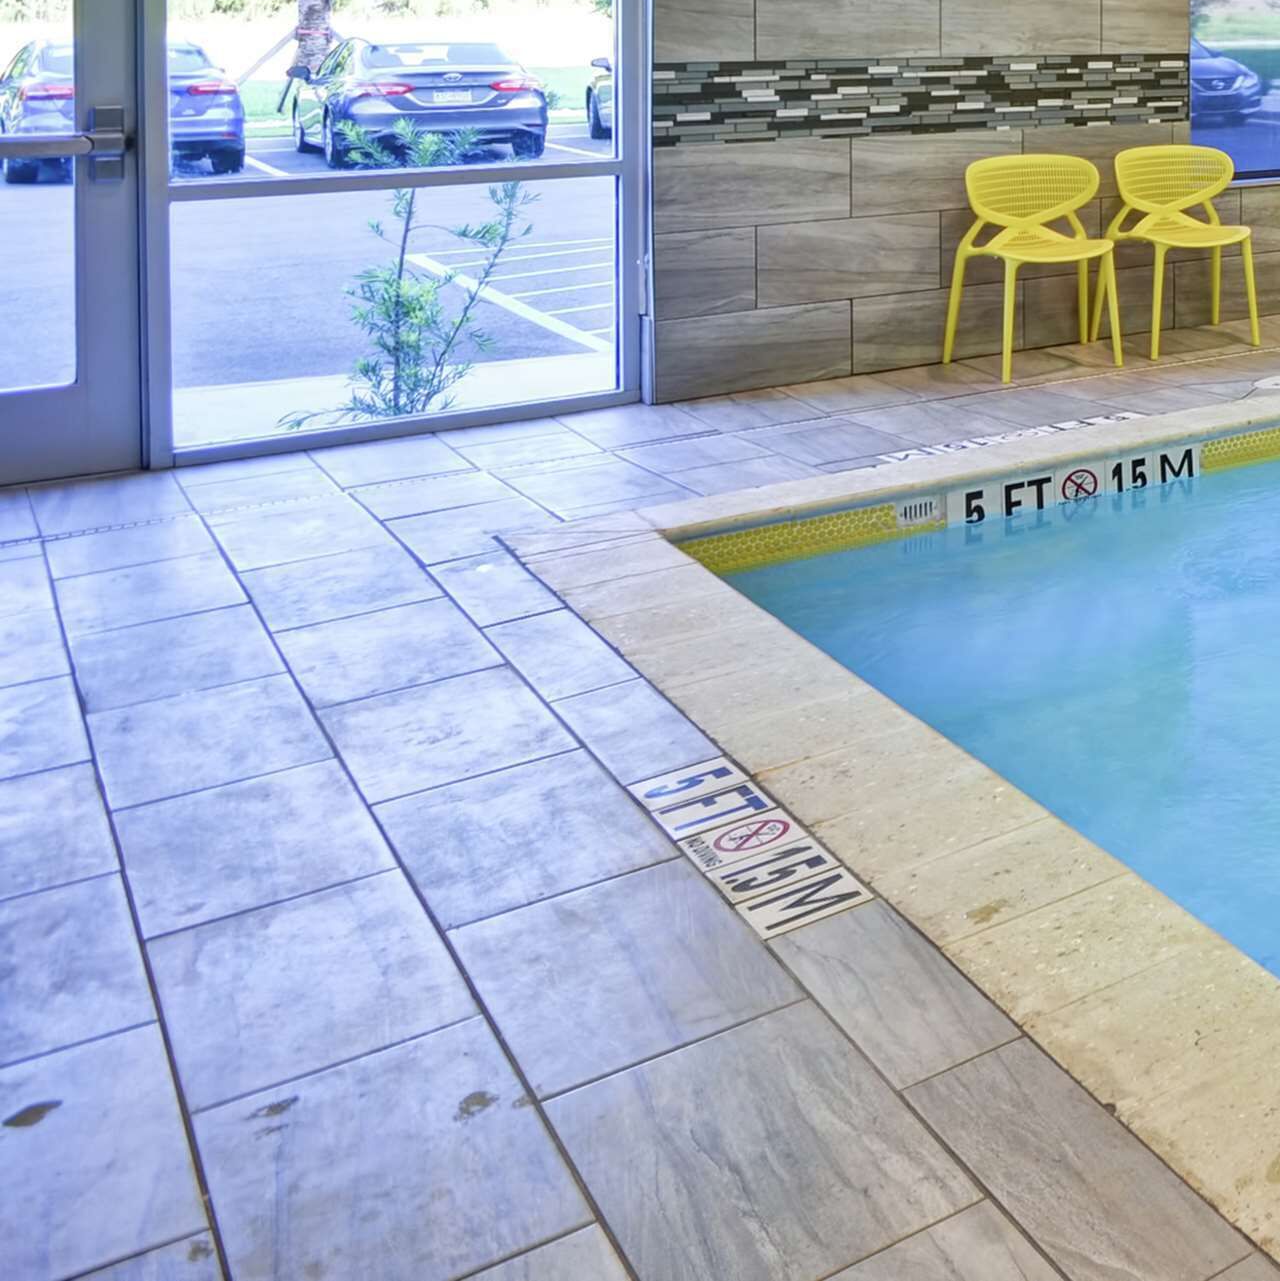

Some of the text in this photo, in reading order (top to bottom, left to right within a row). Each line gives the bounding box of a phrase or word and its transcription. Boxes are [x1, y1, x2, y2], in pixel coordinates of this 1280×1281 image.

[965, 490, 986, 524] 5
[1004, 476, 1052, 517] FT
[1160, 448, 1194, 483] M
[644, 766, 733, 799] 5
[659, 784, 768, 831] FT
[747, 873, 862, 931] M
